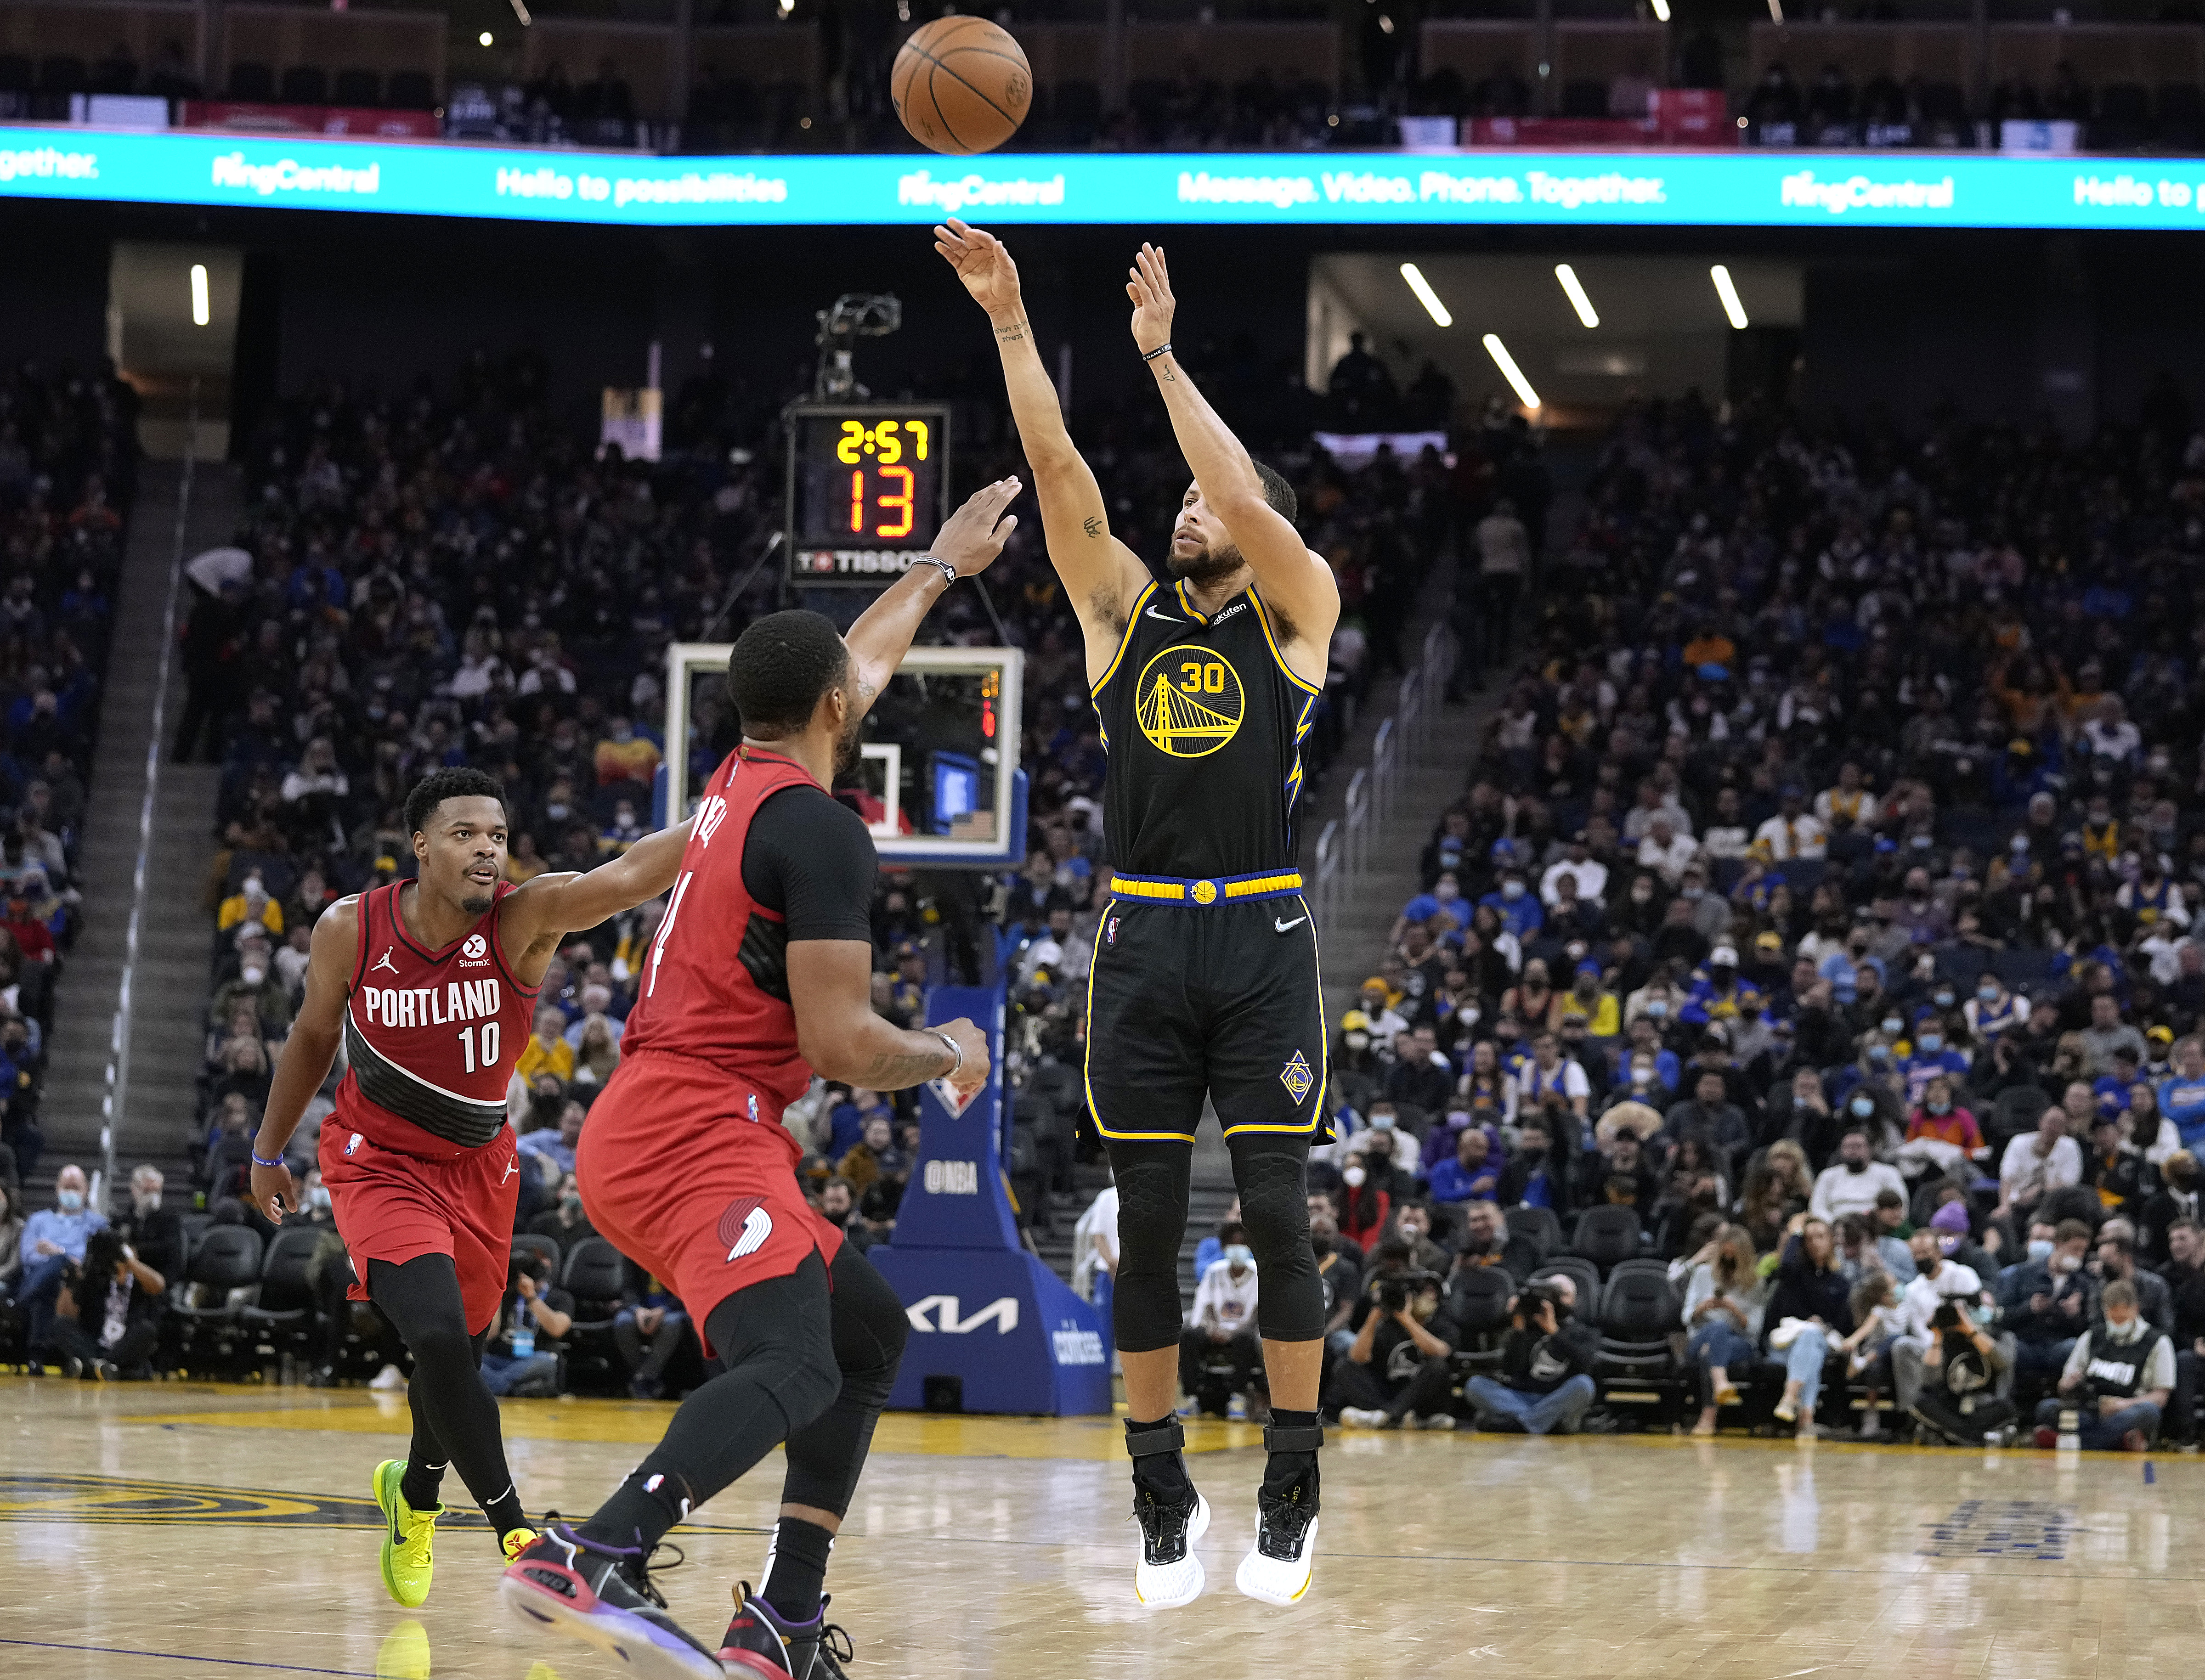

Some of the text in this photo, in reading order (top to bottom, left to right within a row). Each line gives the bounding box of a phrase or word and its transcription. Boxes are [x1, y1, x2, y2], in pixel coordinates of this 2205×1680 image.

[0, 147, 99, 180] gether.
[212, 152, 379, 195] RingCentral
[496, 167, 787, 208] Hello to possibilities
[898, 170, 1065, 211] RingCentral
[1177, 171, 1668, 209] Message. Video. Phone. Together.
[1781, 170, 1954, 213] RingCentral
[2074, 176, 2153, 206] Hello
[2157, 179, 2192, 207] to
[1146, 350, 1161, 359] NAME
[837, 420, 928, 464] 2:57
[851, 465, 914, 537] 13
[835, 550, 928, 573] TISSO
[1181, 662, 1224, 693] 30
[459, 958, 490, 968] StormX
[362, 978, 501, 1028] PORTLAND
[458, 1021, 501, 1074] 10
[924, 1160, 978, 1194] @NBA
